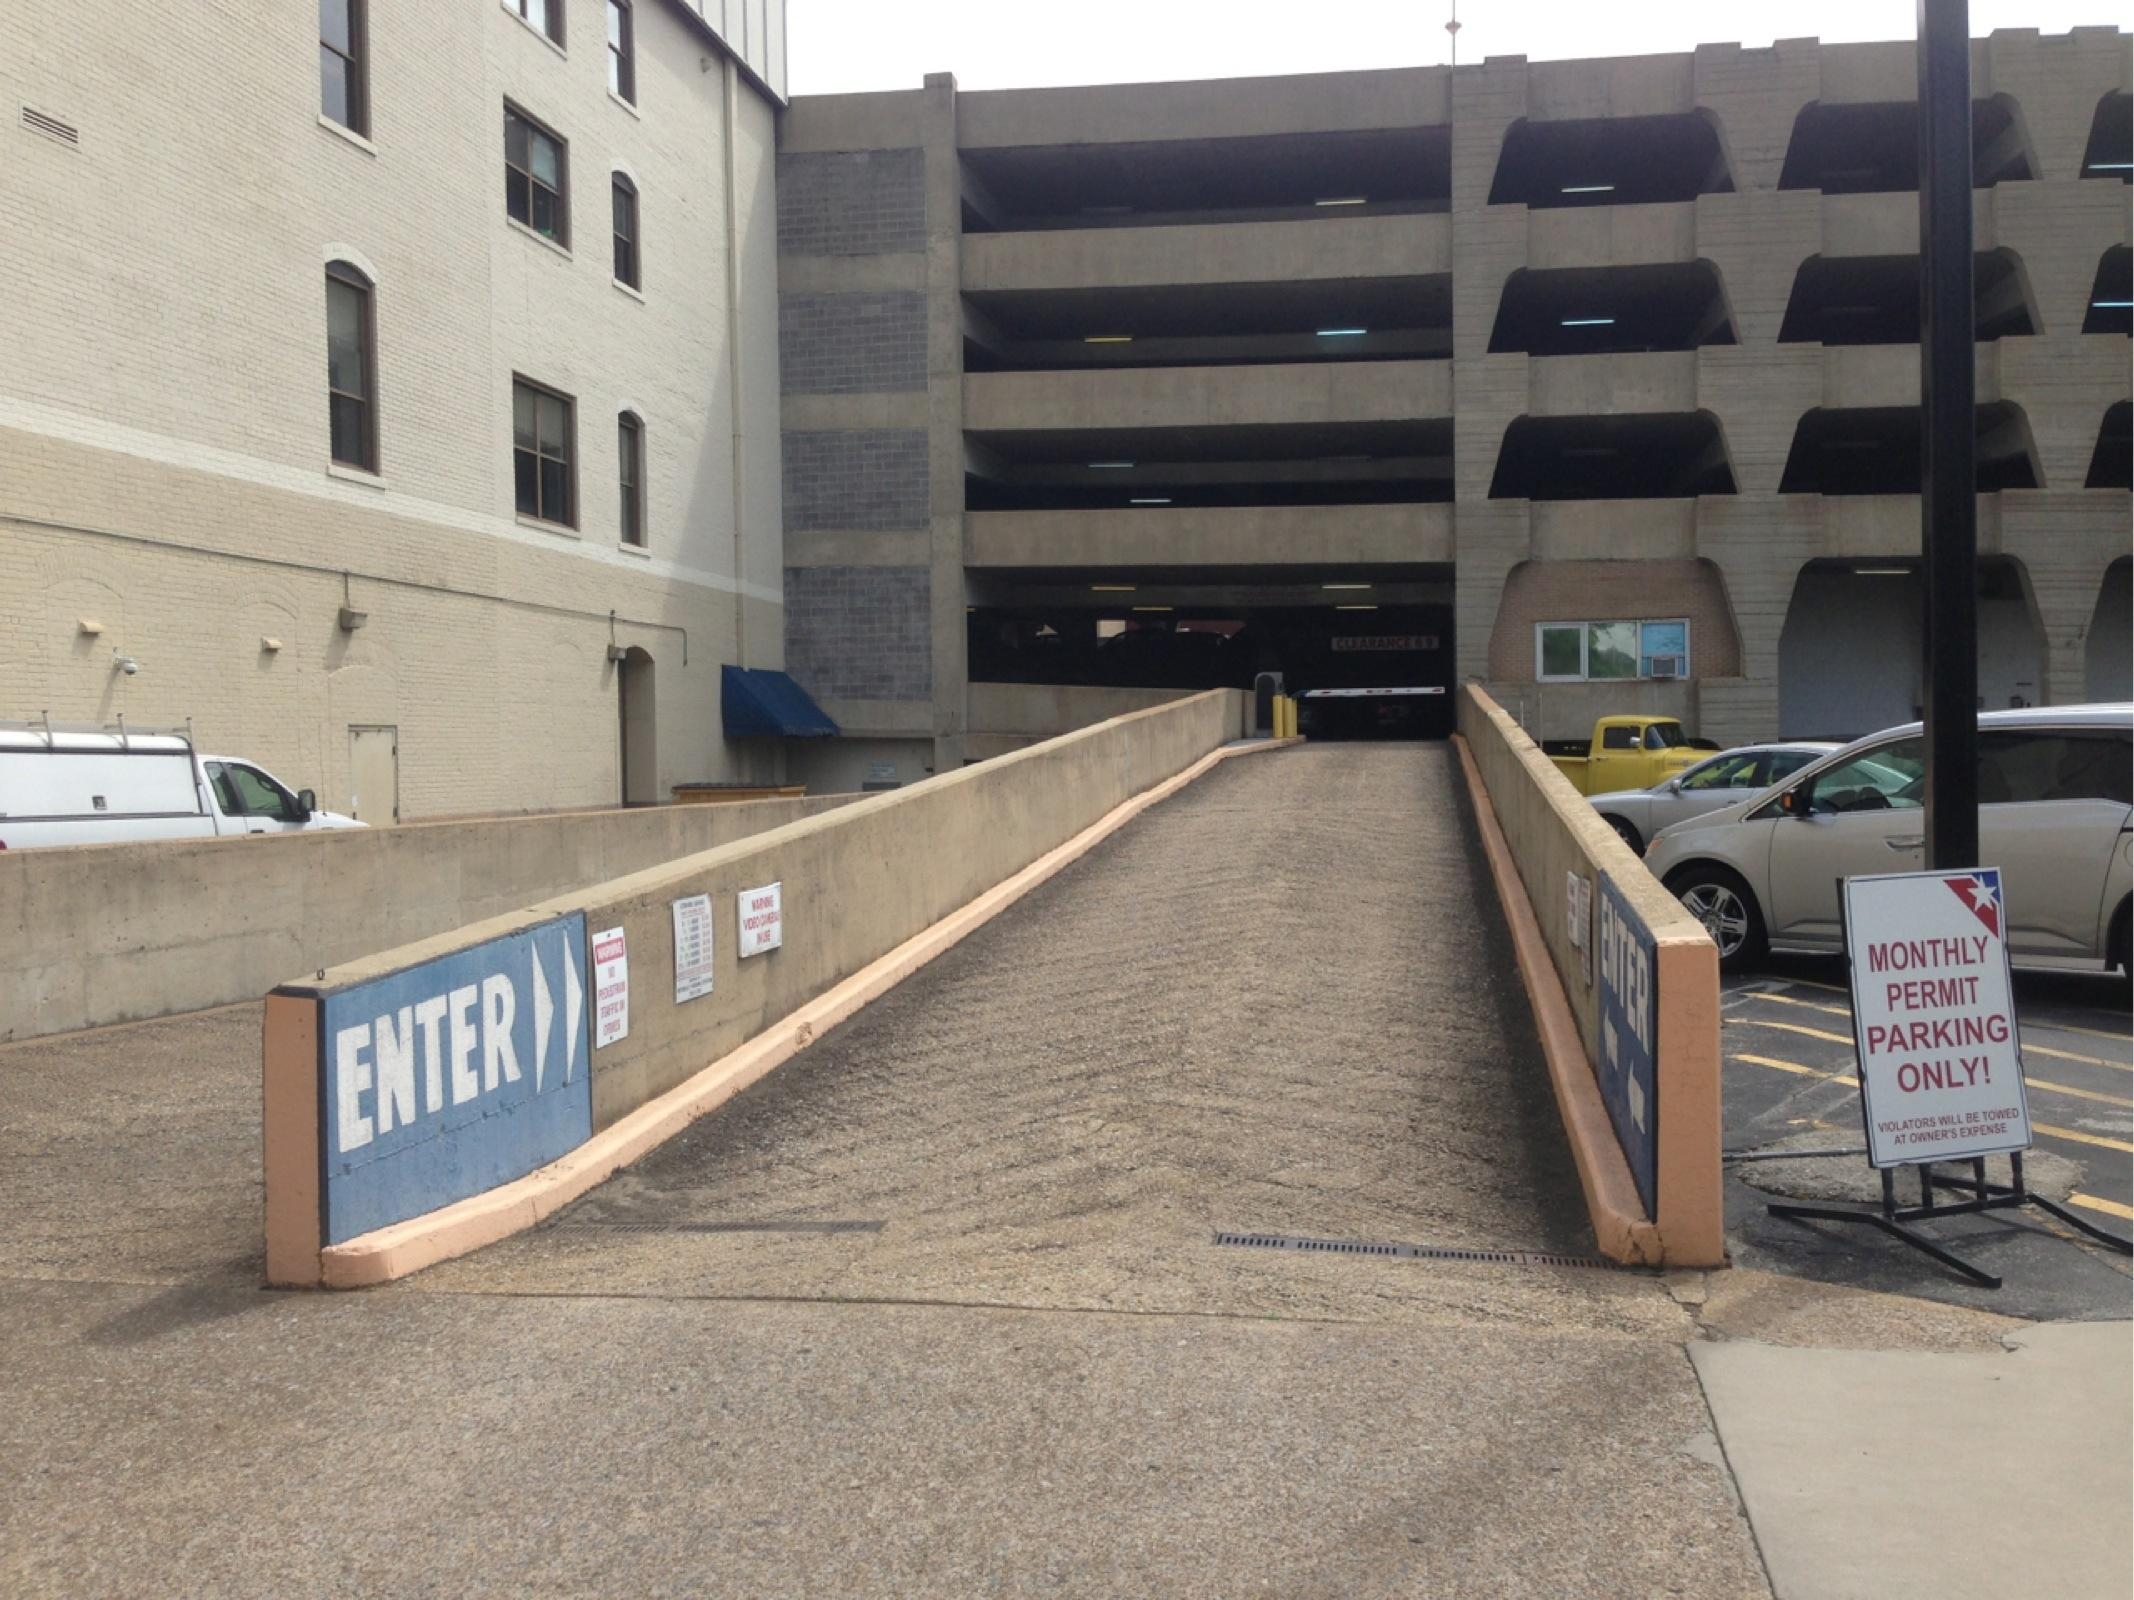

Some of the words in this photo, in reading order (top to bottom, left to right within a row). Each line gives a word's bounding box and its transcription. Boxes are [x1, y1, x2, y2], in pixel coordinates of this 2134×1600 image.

[1336, 637, 1410, 650] CLEARANCE
[1868, 935, 1989, 973] MONTHLY
[1601, 892, 1649, 1057] ENTER
[1887, 976, 1979, 1012] PERMIT
[1867, 1014, 2010, 1055] PARKING
[336, 972, 522, 1153] ENTER
[1897, 1056, 1992, 1093] ONLY!
[1877, 1116, 1937, 1133] VIOLATORS
[1937, 1113, 1964, 1127] WILL
[1966, 1111, 1980, 1124] BE
[1982, 1107, 2019, 1121] TOWED
[1894, 1134, 1906, 1145] AT
[1909, 1128, 1958, 1144] OWNER'S
[1960, 1122, 2009, 1138] EXPENSE
